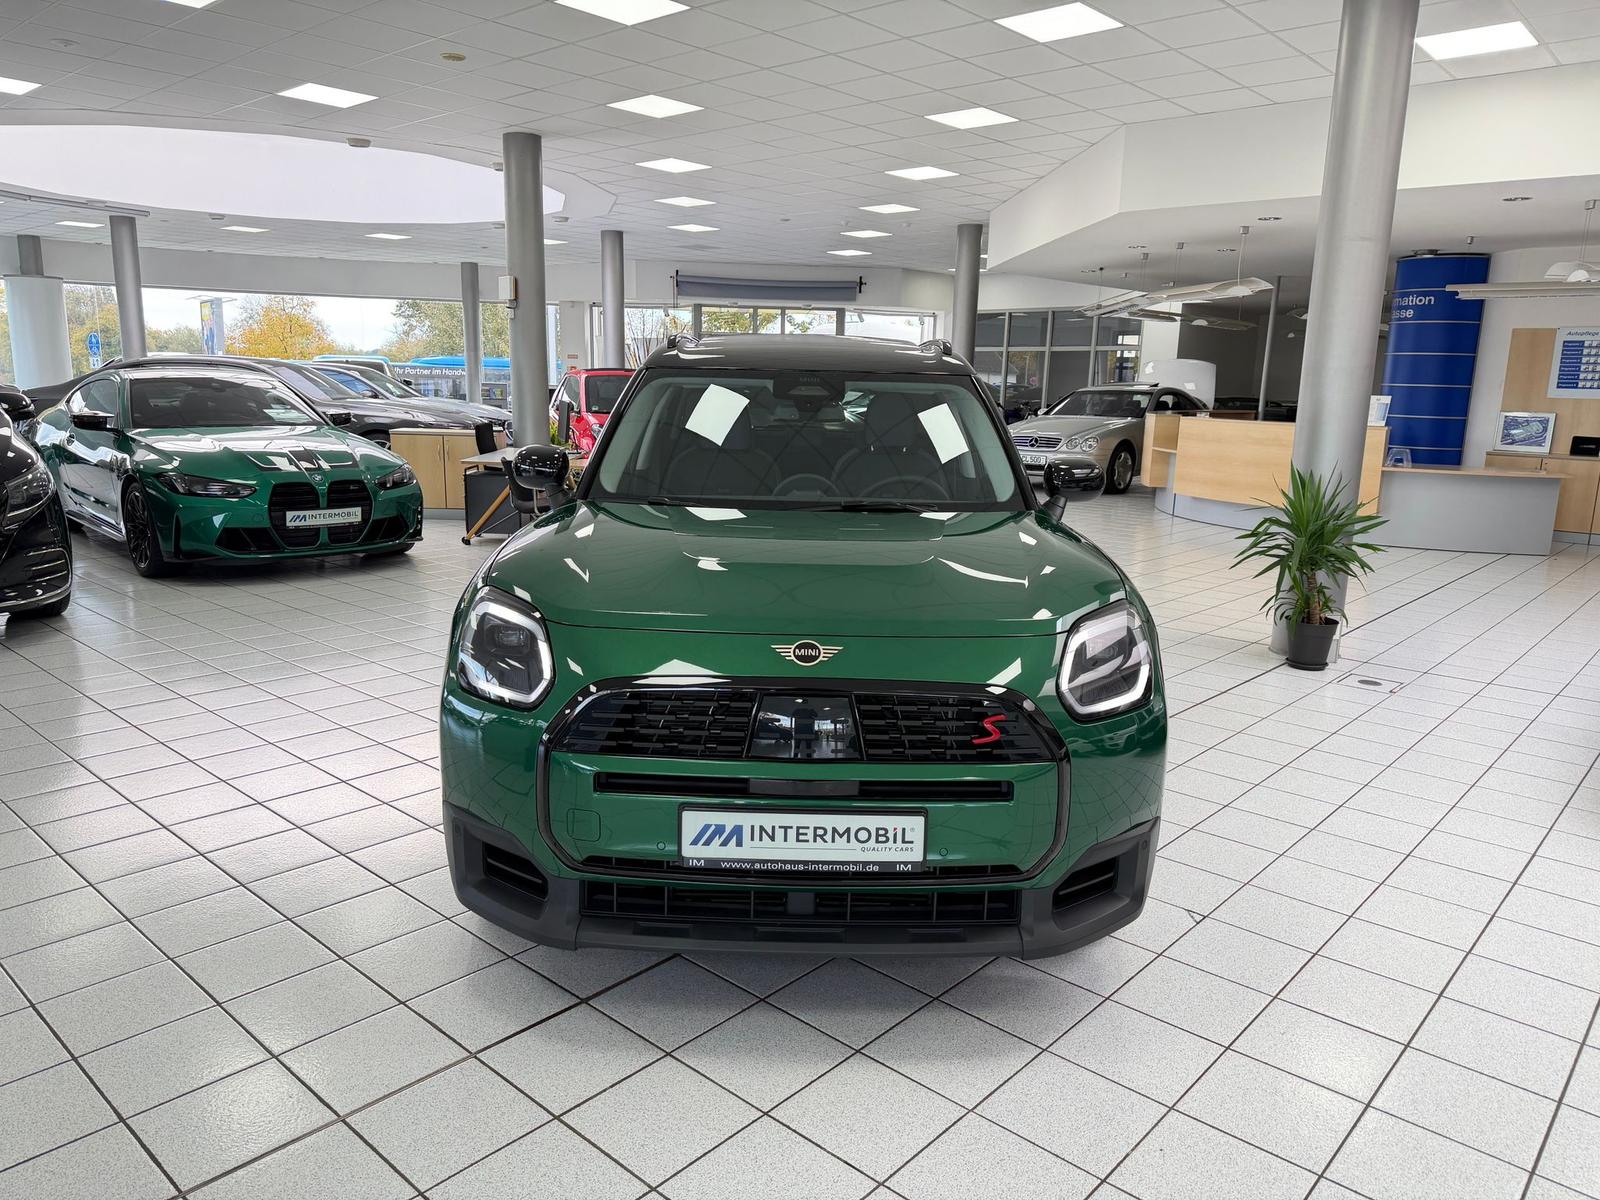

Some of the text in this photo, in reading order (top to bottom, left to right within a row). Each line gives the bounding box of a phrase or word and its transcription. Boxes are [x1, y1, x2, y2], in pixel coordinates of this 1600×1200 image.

[405, 367, 431, 375] Partner
[795, 648, 819, 656] MINI
[972, 713, 1008, 744] S
[689, 859, 705, 867] IM
[720, 861, 879, 872] www.autohaus-intermobil.de
